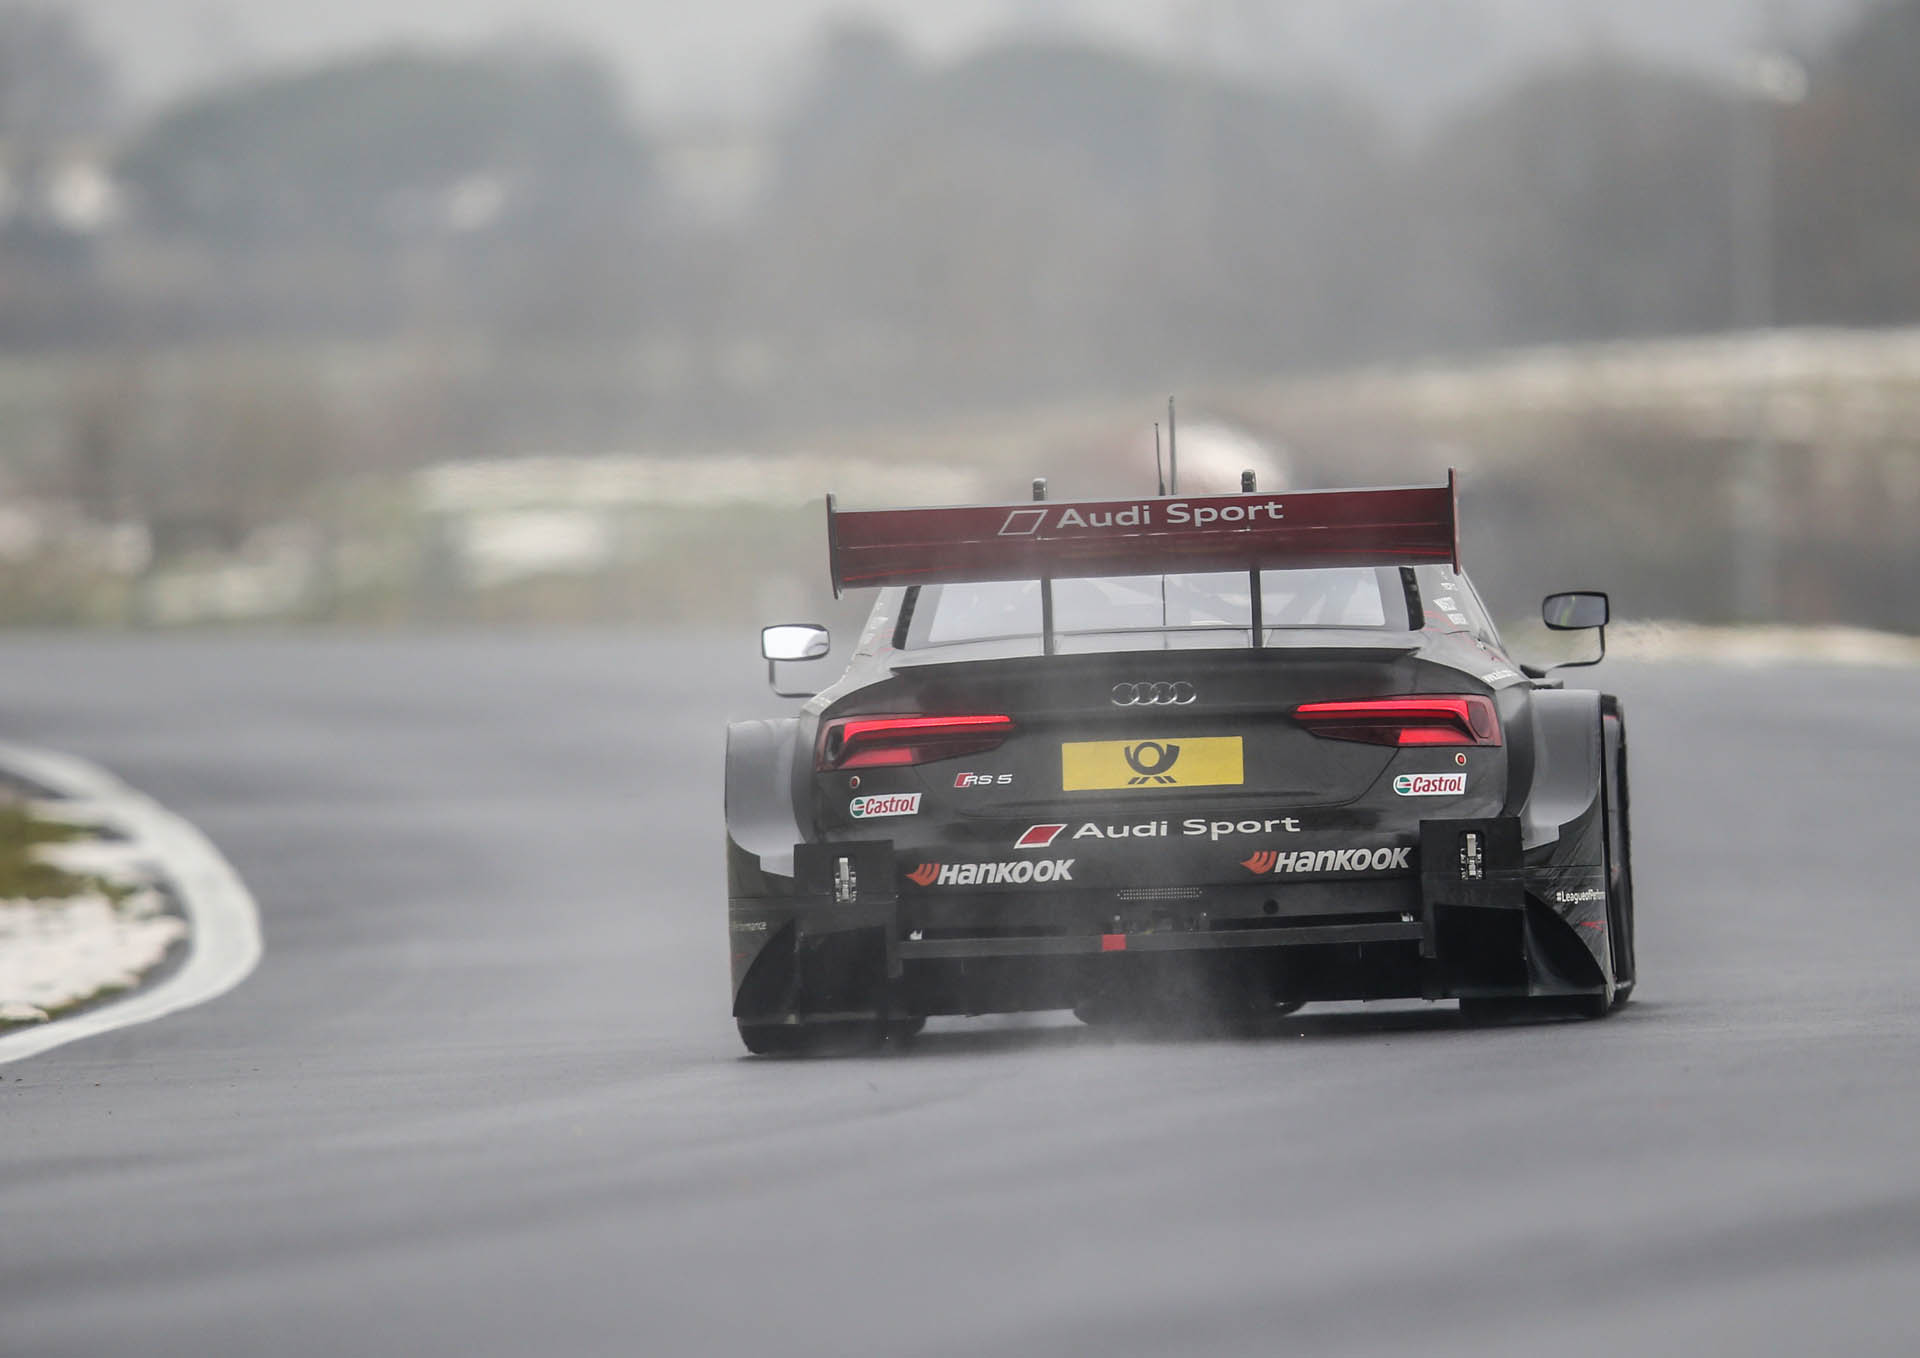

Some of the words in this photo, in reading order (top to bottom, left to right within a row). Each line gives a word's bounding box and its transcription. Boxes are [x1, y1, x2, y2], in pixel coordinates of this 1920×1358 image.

[1056, 505, 1150, 528] Audi
[1167, 501, 1284, 527] Sport
[963, 773, 993, 786] RS
[997, 774, 1013, 785] 5
[1412, 774, 1463, 793] Castrol
[866, 797, 915, 815] Castrol
[1073, 821, 1168, 839] Audi
[1183, 817, 1300, 841] Sport
